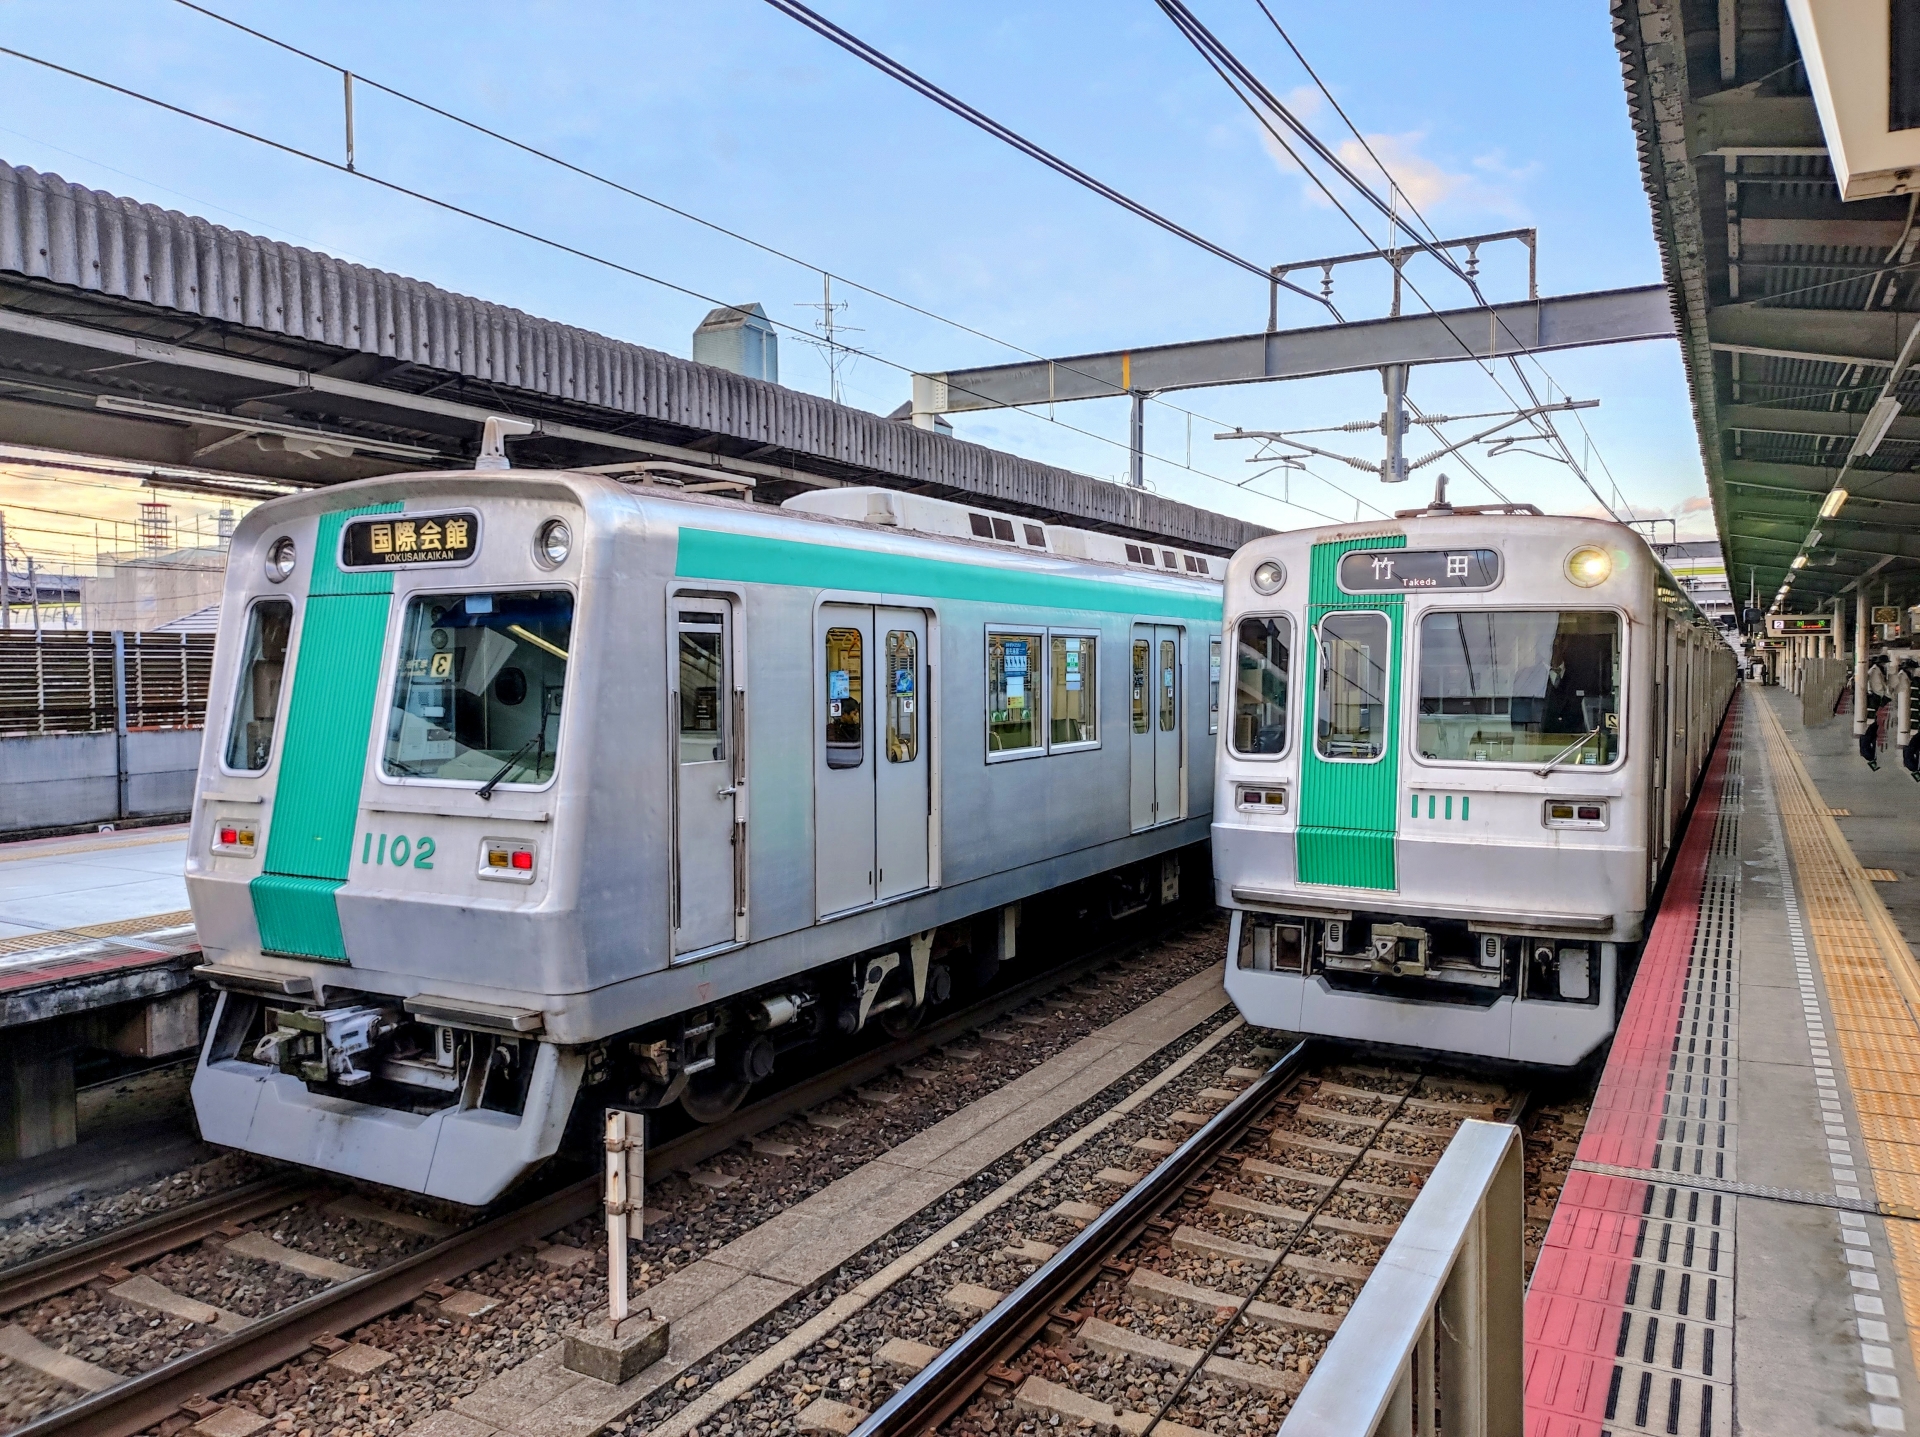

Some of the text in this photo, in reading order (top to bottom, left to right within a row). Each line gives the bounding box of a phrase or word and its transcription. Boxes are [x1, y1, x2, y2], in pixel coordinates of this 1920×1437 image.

[371, 518, 468, 554] 国際会館
[385, 550, 454, 563] KOKUSAIKAIKAN
[1371, 555, 1469, 580] 竹田
[1402, 578, 1437, 587] Takeda
[1411, 794, 1470, 821] 1111
[362, 832, 436, 870] 1102
